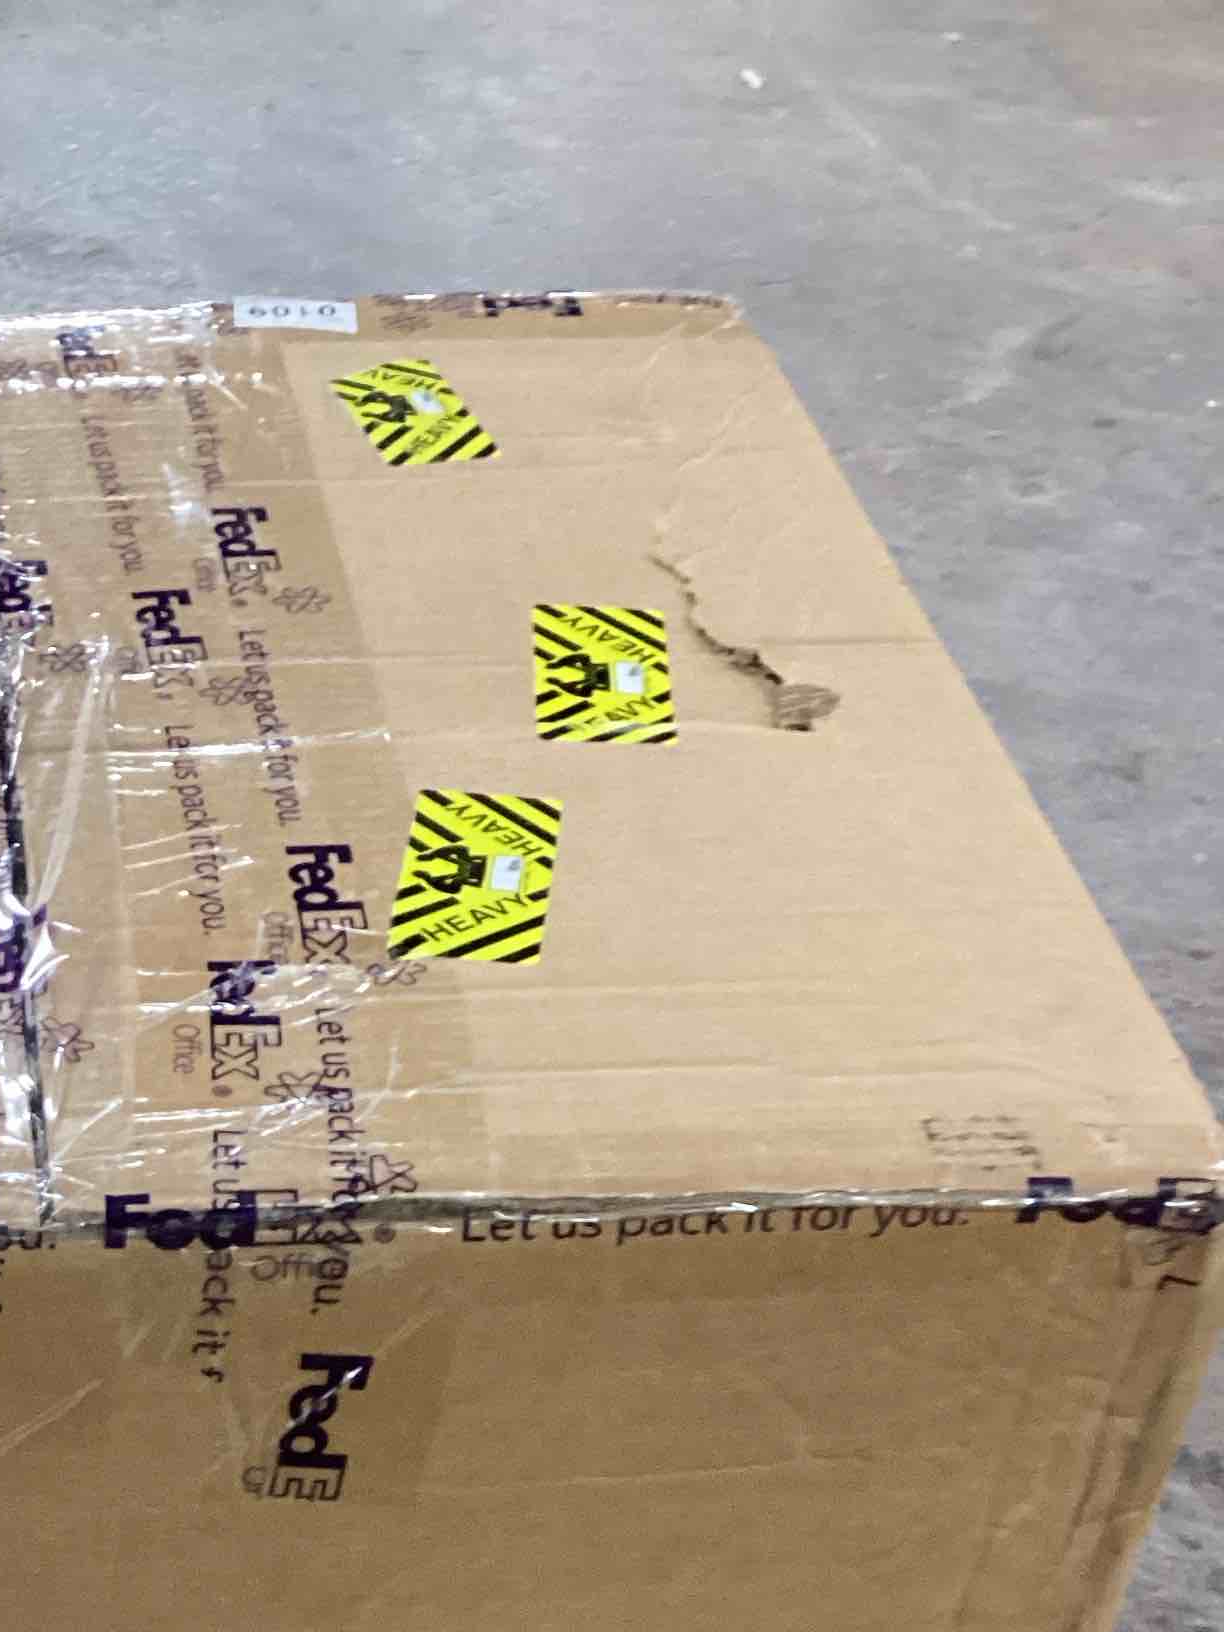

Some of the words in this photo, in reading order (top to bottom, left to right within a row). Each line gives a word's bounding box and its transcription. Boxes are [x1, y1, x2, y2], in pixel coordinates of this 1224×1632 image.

[210, 507, 282, 597] FedEx
[238, 629, 271, 661] Let
[560, 613, 656, 664] HEAVY
[245, 665, 272, 685] us
[243, 690, 290, 736] pack
[567, 696, 656, 733] EAVY
[165, 725, 197, 756] Le
[264, 754, 299, 782] for
[170, 784, 218, 831] pack
[446, 801, 543, 859] HEAVY
[285, 844, 369, 964] FedEx
[421, 892, 528, 943] HEAVY
[314, 1008, 352, 1045] Let
[321, 1051, 352, 1079] us
[212, 1130, 248, 1171] Let
[462, 1205, 537, 1243] Let
[551, 1217, 604, 1242] us
[616, 1205, 730, 1247] pack
[742, 1203, 777, 1235] it
[790, 1202, 856, 1232] for
[192, 1329, 232, 1355] it
[268, 1352, 375, 1501] FedE
